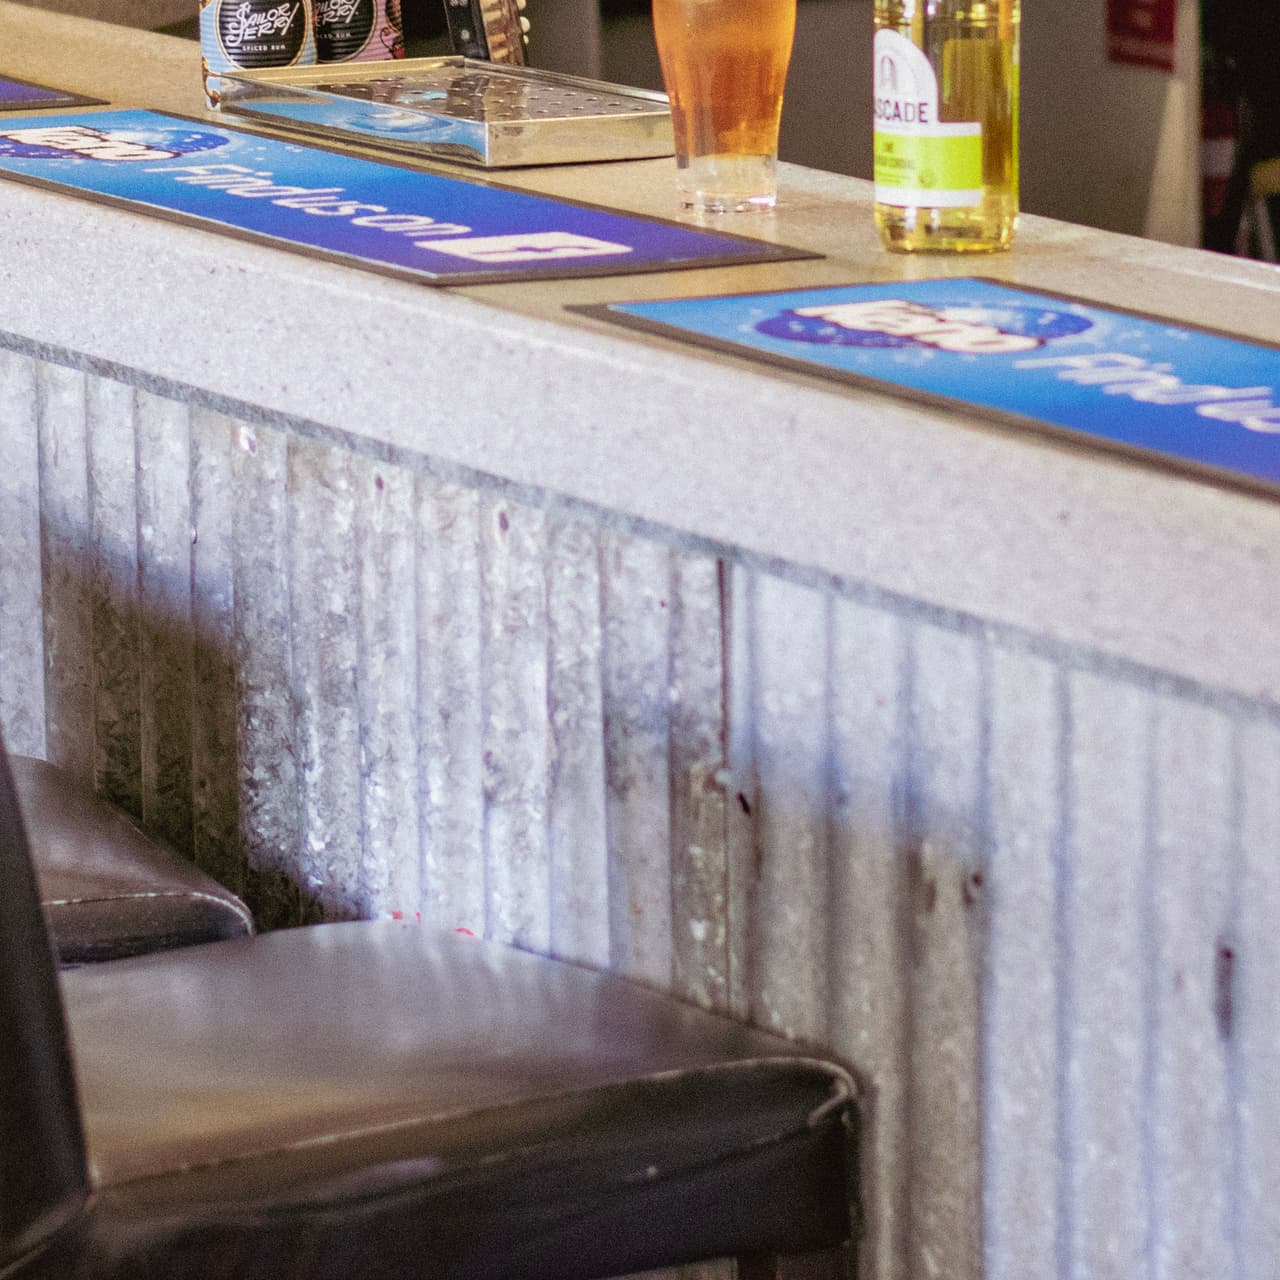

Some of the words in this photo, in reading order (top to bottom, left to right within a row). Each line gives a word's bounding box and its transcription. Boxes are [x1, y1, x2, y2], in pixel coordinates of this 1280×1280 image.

[874, 98, 928, 124] SCADE
[144, 164, 344, 198] Find
[272, 193, 388, 216] us
[351, 214, 472, 237] on
